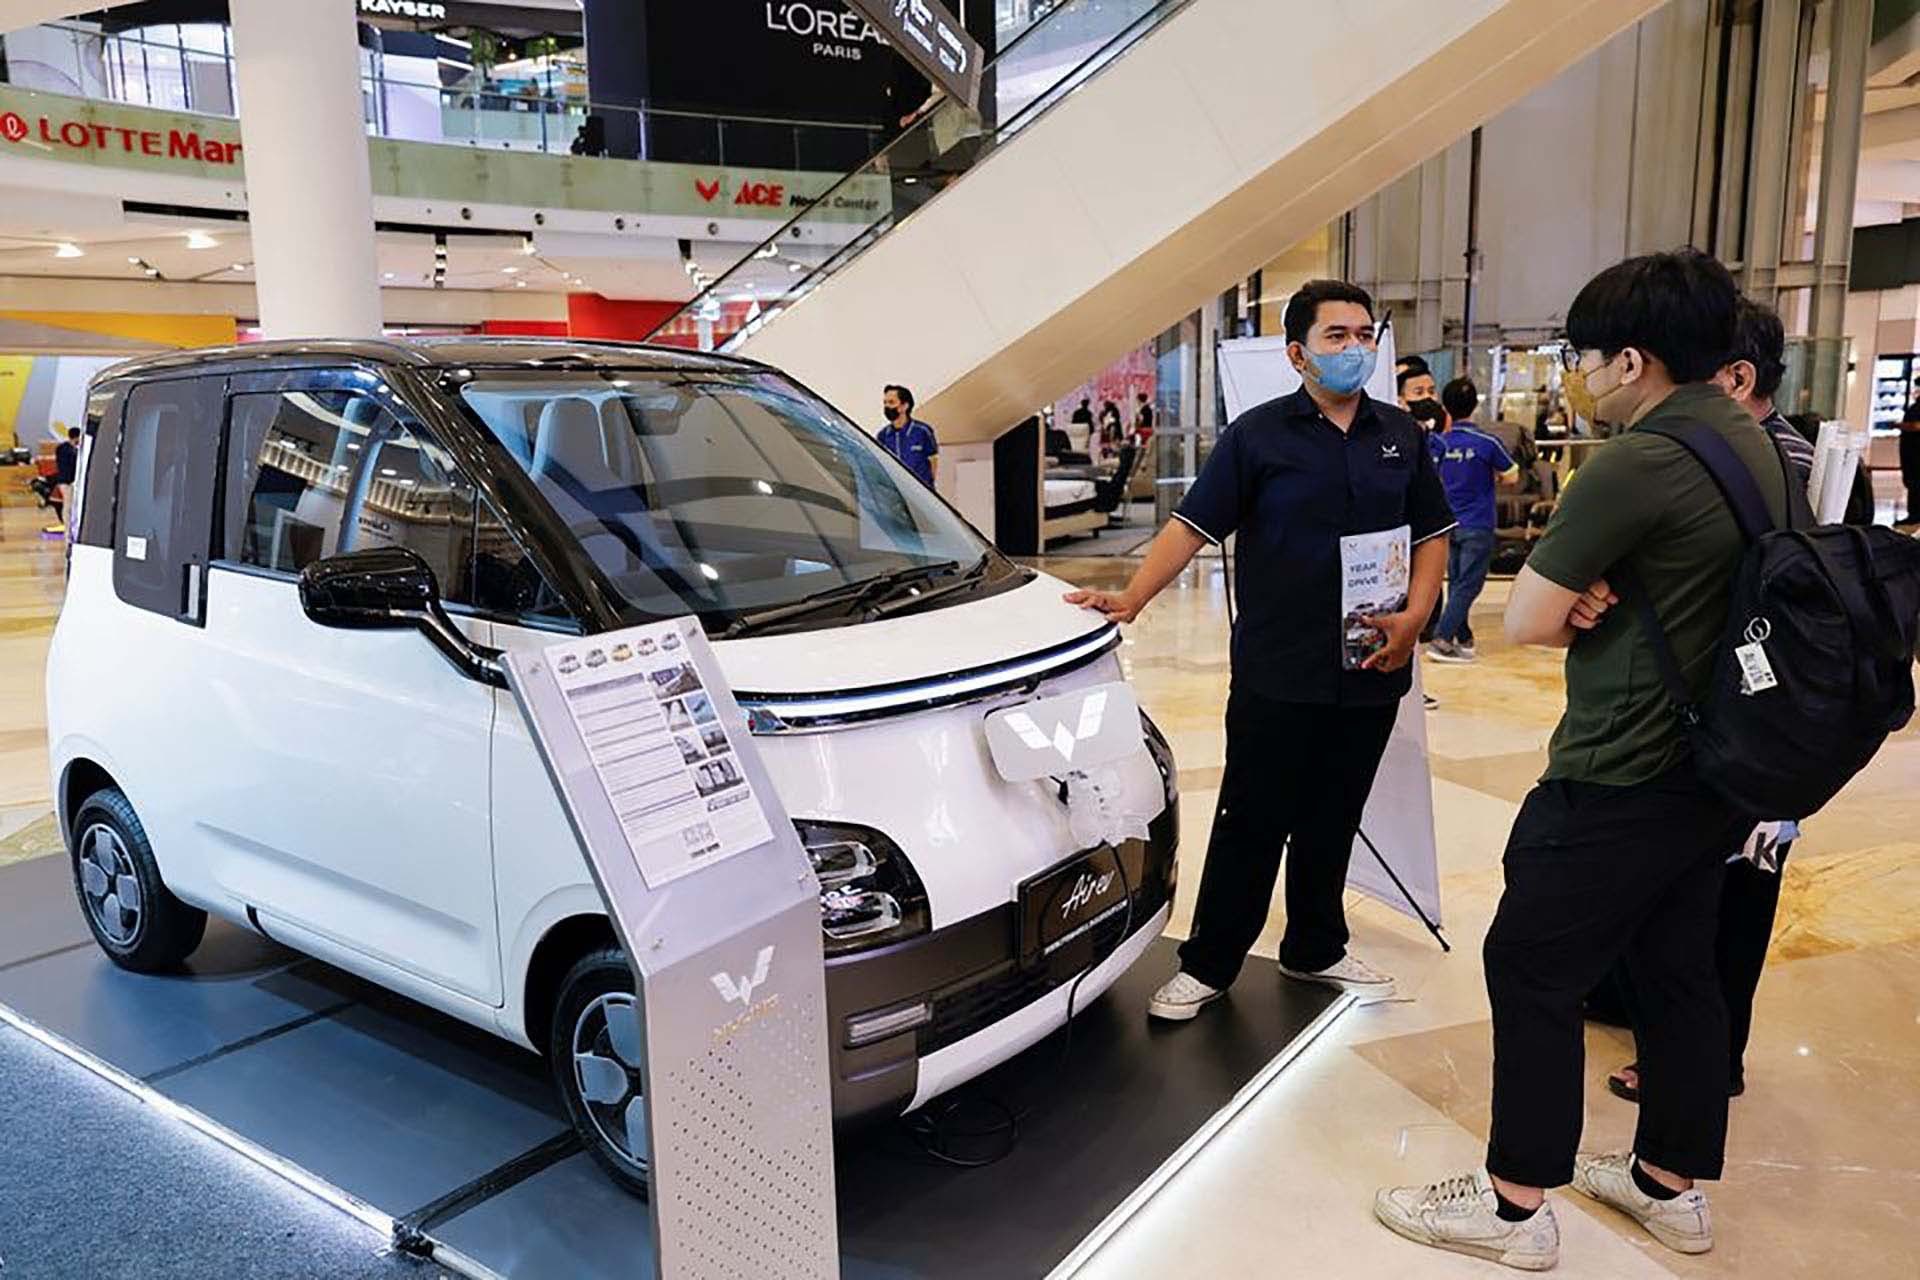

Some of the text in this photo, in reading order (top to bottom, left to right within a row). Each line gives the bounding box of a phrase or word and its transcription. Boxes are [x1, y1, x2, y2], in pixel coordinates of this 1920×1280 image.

[361, 0, 446, 19] KAYSER
[766, 2, 889, 46] L'ORÉA
[813, 43, 862, 60] PARIS
[39, 117, 242, 164] LOTTE Mar
[734, 180, 784, 207] ACE
